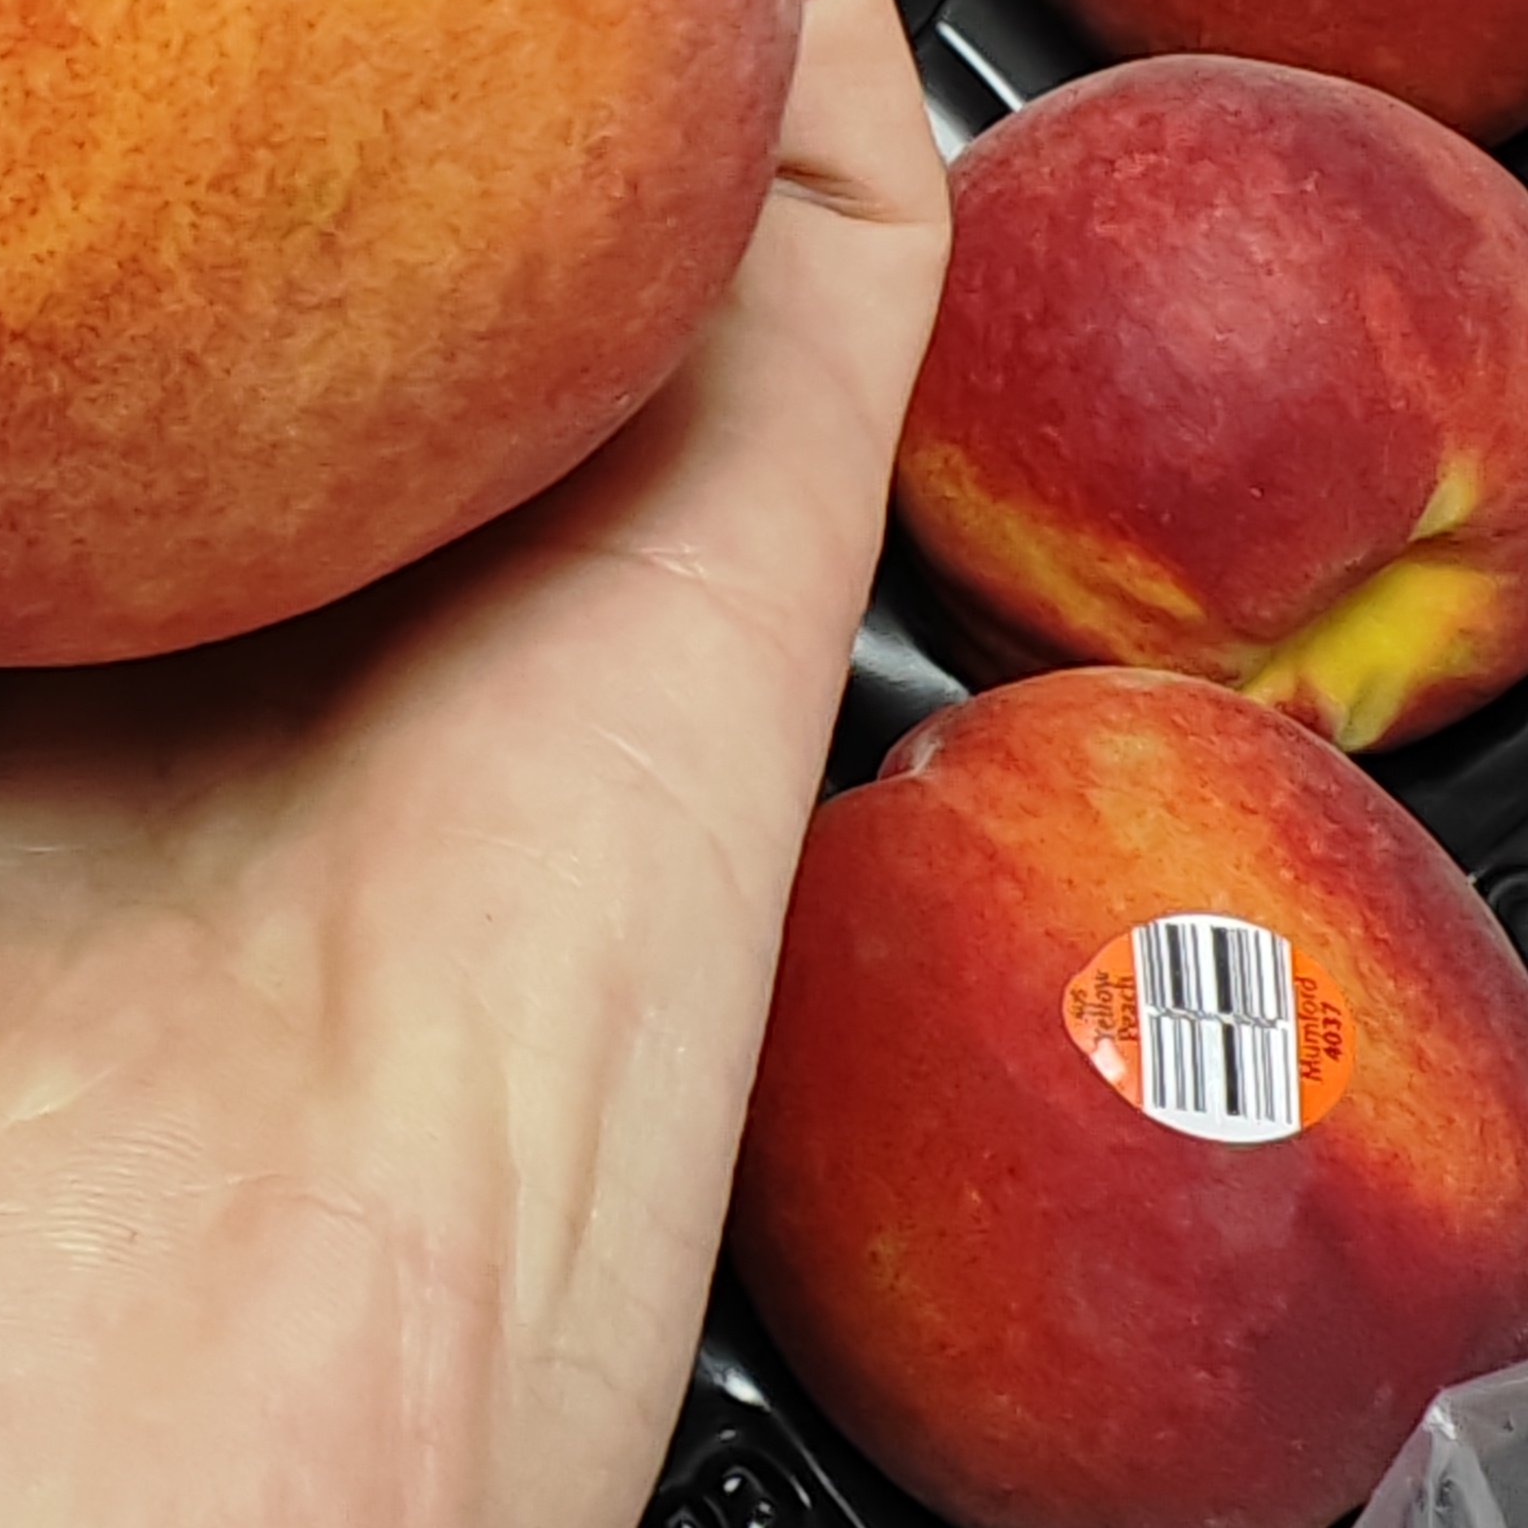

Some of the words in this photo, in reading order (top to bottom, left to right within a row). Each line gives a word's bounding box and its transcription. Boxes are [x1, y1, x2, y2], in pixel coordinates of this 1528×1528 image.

[1085, 970, 1116, 1047] Yellow
[1111, 976, 1138, 1041] Peach
[1294, 976, 1323, 1083] Mumford
[1320, 1001, 1344, 1062] 4037
